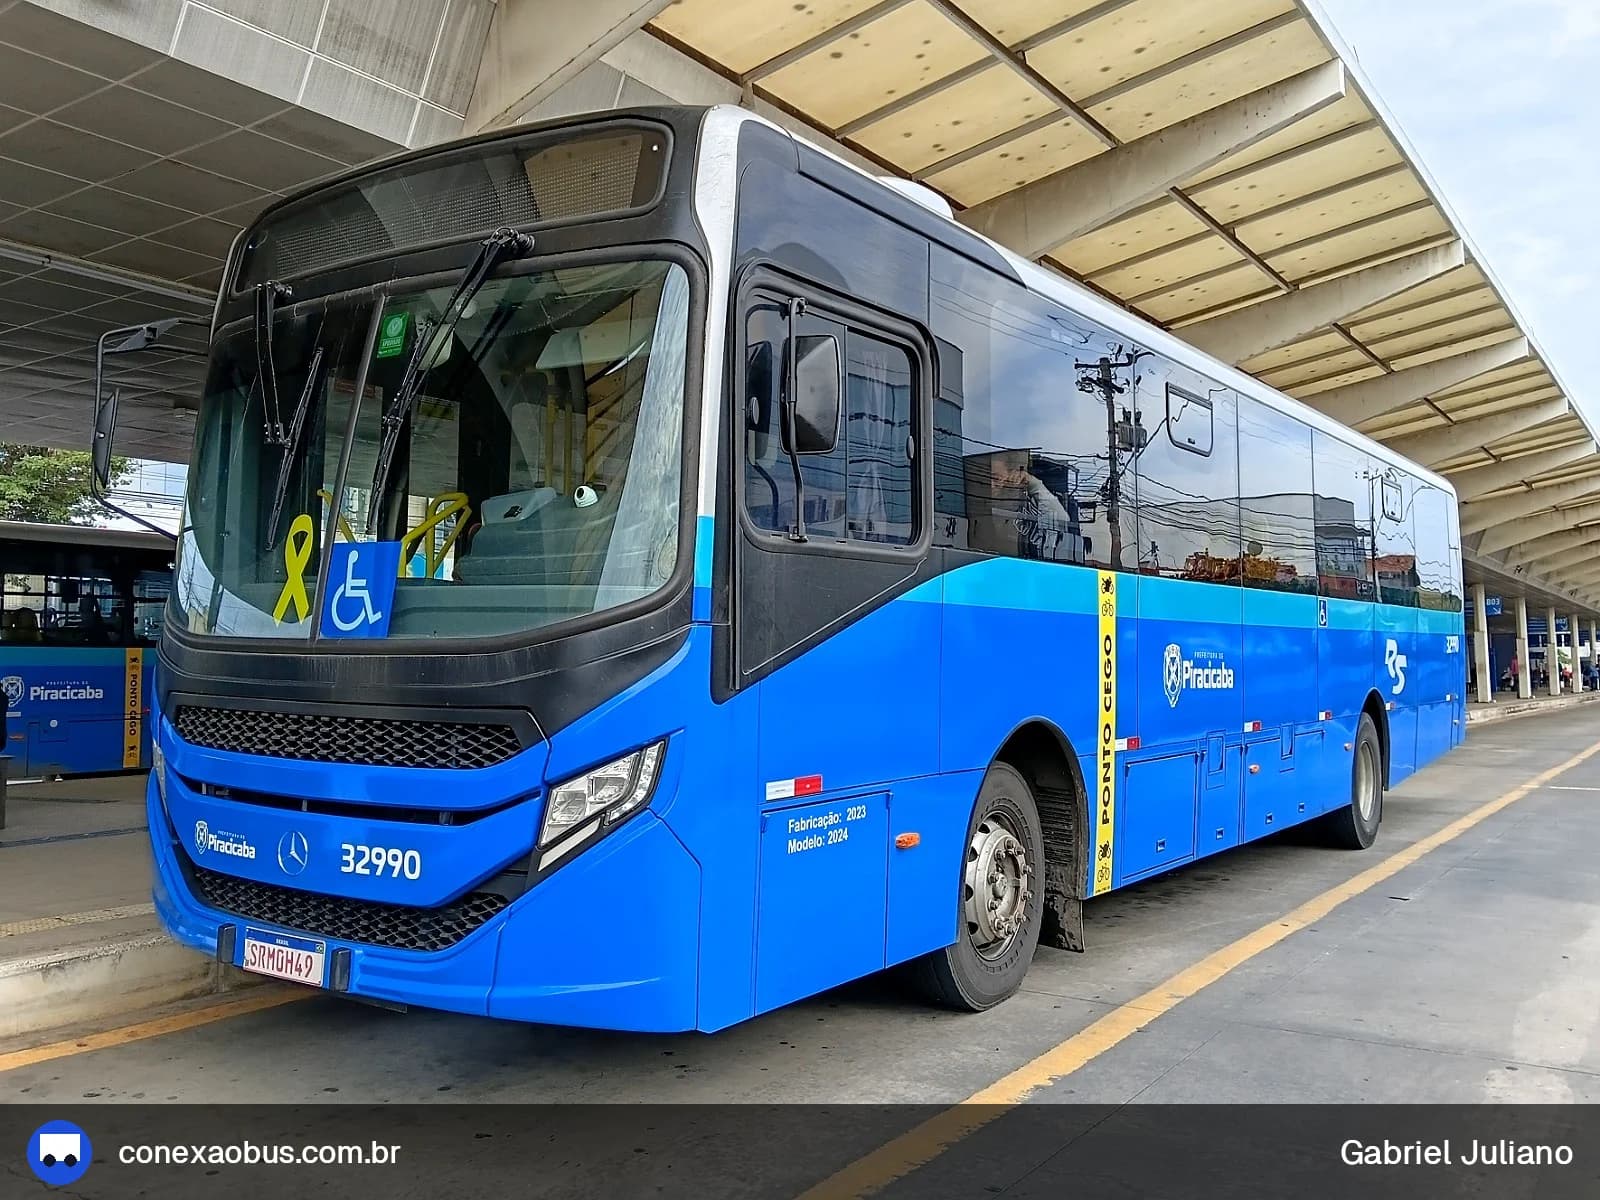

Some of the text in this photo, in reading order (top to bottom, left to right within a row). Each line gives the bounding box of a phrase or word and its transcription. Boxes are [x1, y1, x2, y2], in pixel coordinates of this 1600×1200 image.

[1182, 659, 1234, 689] Piracicaba
[30, 686, 104, 701] Piracicaba
[129, 674, 138, 736] PONTO CEGO
[1102, 634, 1112, 825] PONTO CEGO
[788, 804, 867, 834] Fabricação: 2023
[208, 833, 256, 859] Piracicaba
[787, 827, 849, 854] Modelo: 2024
[340, 843, 421, 880] 32990
